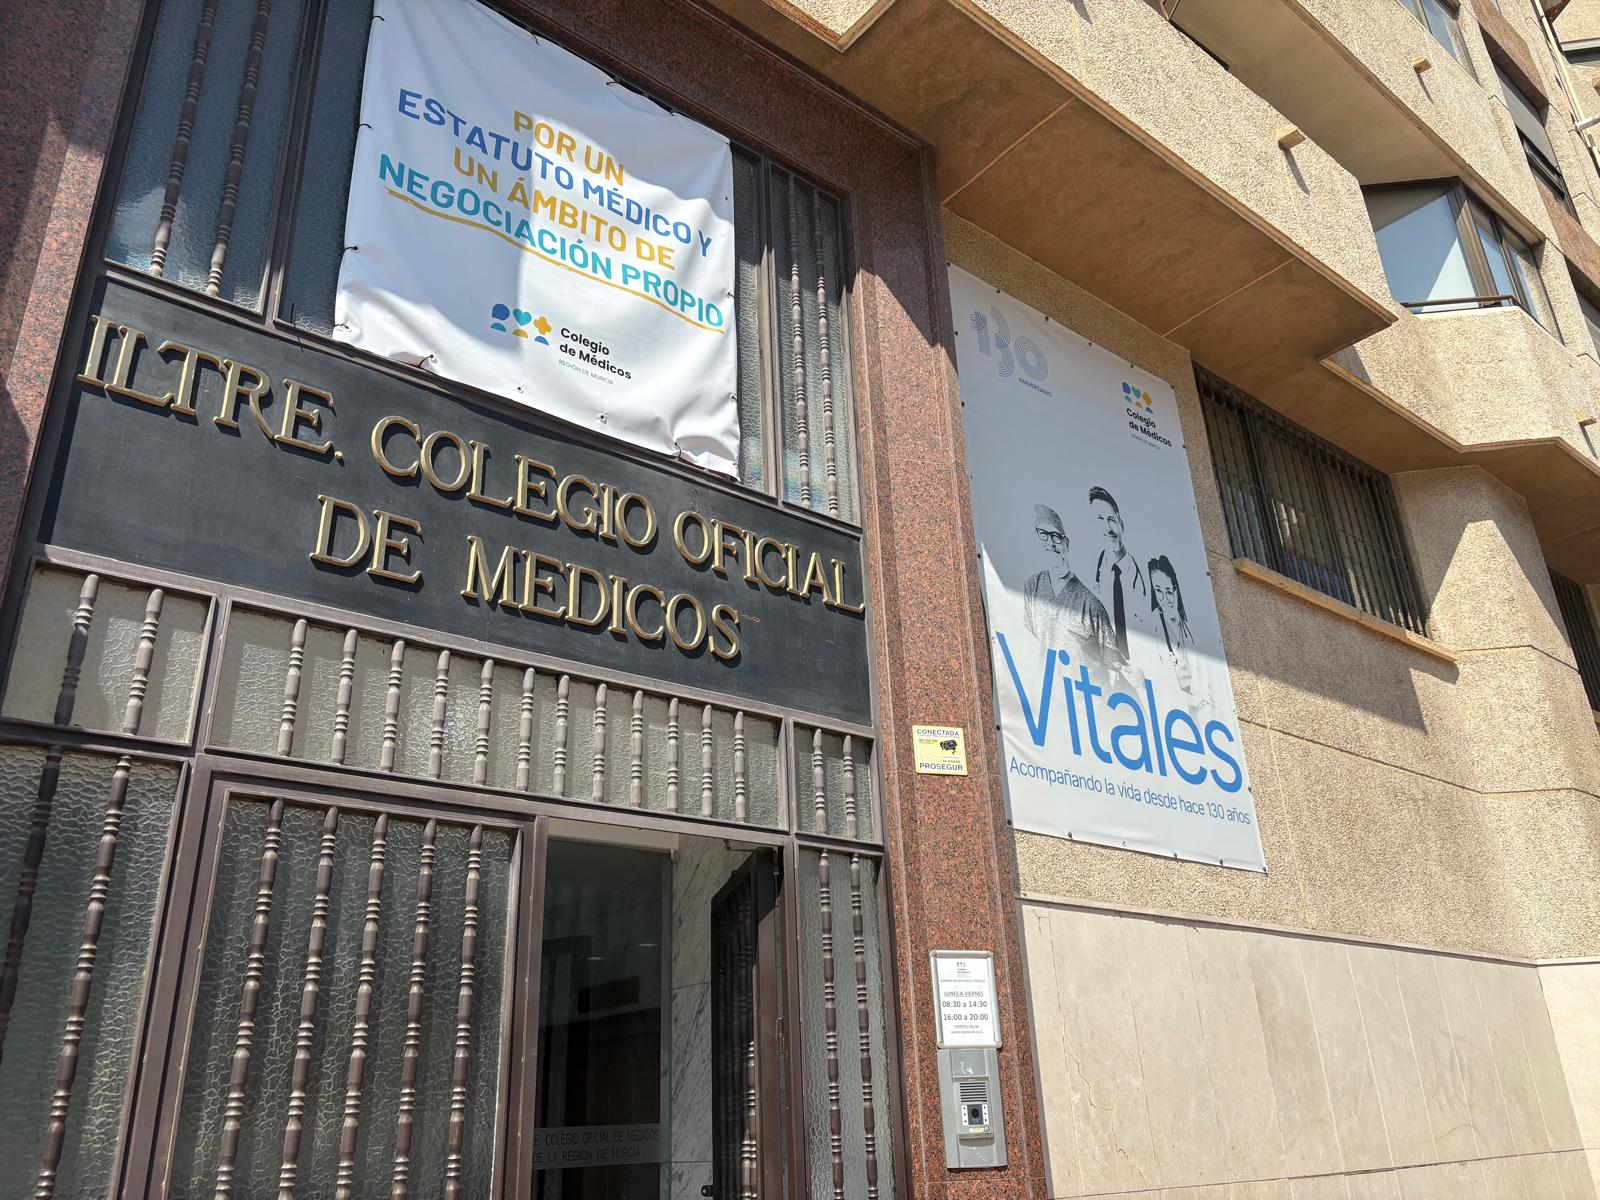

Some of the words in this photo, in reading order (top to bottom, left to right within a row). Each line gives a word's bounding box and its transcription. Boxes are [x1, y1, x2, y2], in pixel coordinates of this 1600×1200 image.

[398, 88, 574, 190] ESTATUTO
[583, 178, 692, 244] MÉDICO
[696, 228, 713, 258] Y
[514, 109, 577, 163] POR
[583, 144, 625, 186] UN
[453, 146, 498, 195] UN
[507, 177, 627, 252] ÁMBITO
[635, 239, 676, 271] DE
[379, 153, 613, 281] NEGOCIACIÓN
[621, 262, 724, 328] PROPIO
[559, 343, 577, 357] de
[579, 350, 632, 380] Médicos
[560, 327, 610, 356] Colegio
[968, 304, 1049, 382] 130
[1126, 407, 1156, 429] Colegio
[1128, 420, 1140, 432] de
[1140, 425, 1172, 448] Médicos
[76, 315, 344, 464] ILTRE.
[371, 415, 658, 549] COLEGIO
[673, 509, 866, 613] OFICIAL
[309, 494, 424, 585] DE
[460, 535, 741, 662] MEDICOS
[995, 630, 1243, 794] Vitales
[919, 763, 963, 771] PROSEGUR
[1010, 756, 1103, 794] Acompañando
[1104, 778, 1116, 796] la
[1116, 782, 1142, 803] vida
[1143, 788, 1178, 811] desde
[1179, 795, 1205, 816] hace
[1205, 801, 1225, 820] 130
[1226, 807, 1251, 825] años
[942, 1000, 961, 1008] 08:30
[968, 1000, 988, 1008] 14:30
[943, 1013, 962, 1021] 16:00
[969, 1013, 989, 1021] 20:00
[532, 1152, 544, 1164] DE
[547, 1151, 558, 1163] LA
[596, 1148, 608, 1160] DE
[545, 1132, 580, 1146] COLEGIO
[582, 1129, 610, 1144] OFICIAL
[614, 1130, 624, 1142] DE
[627, 1128, 660, 1142] MEDICOS
